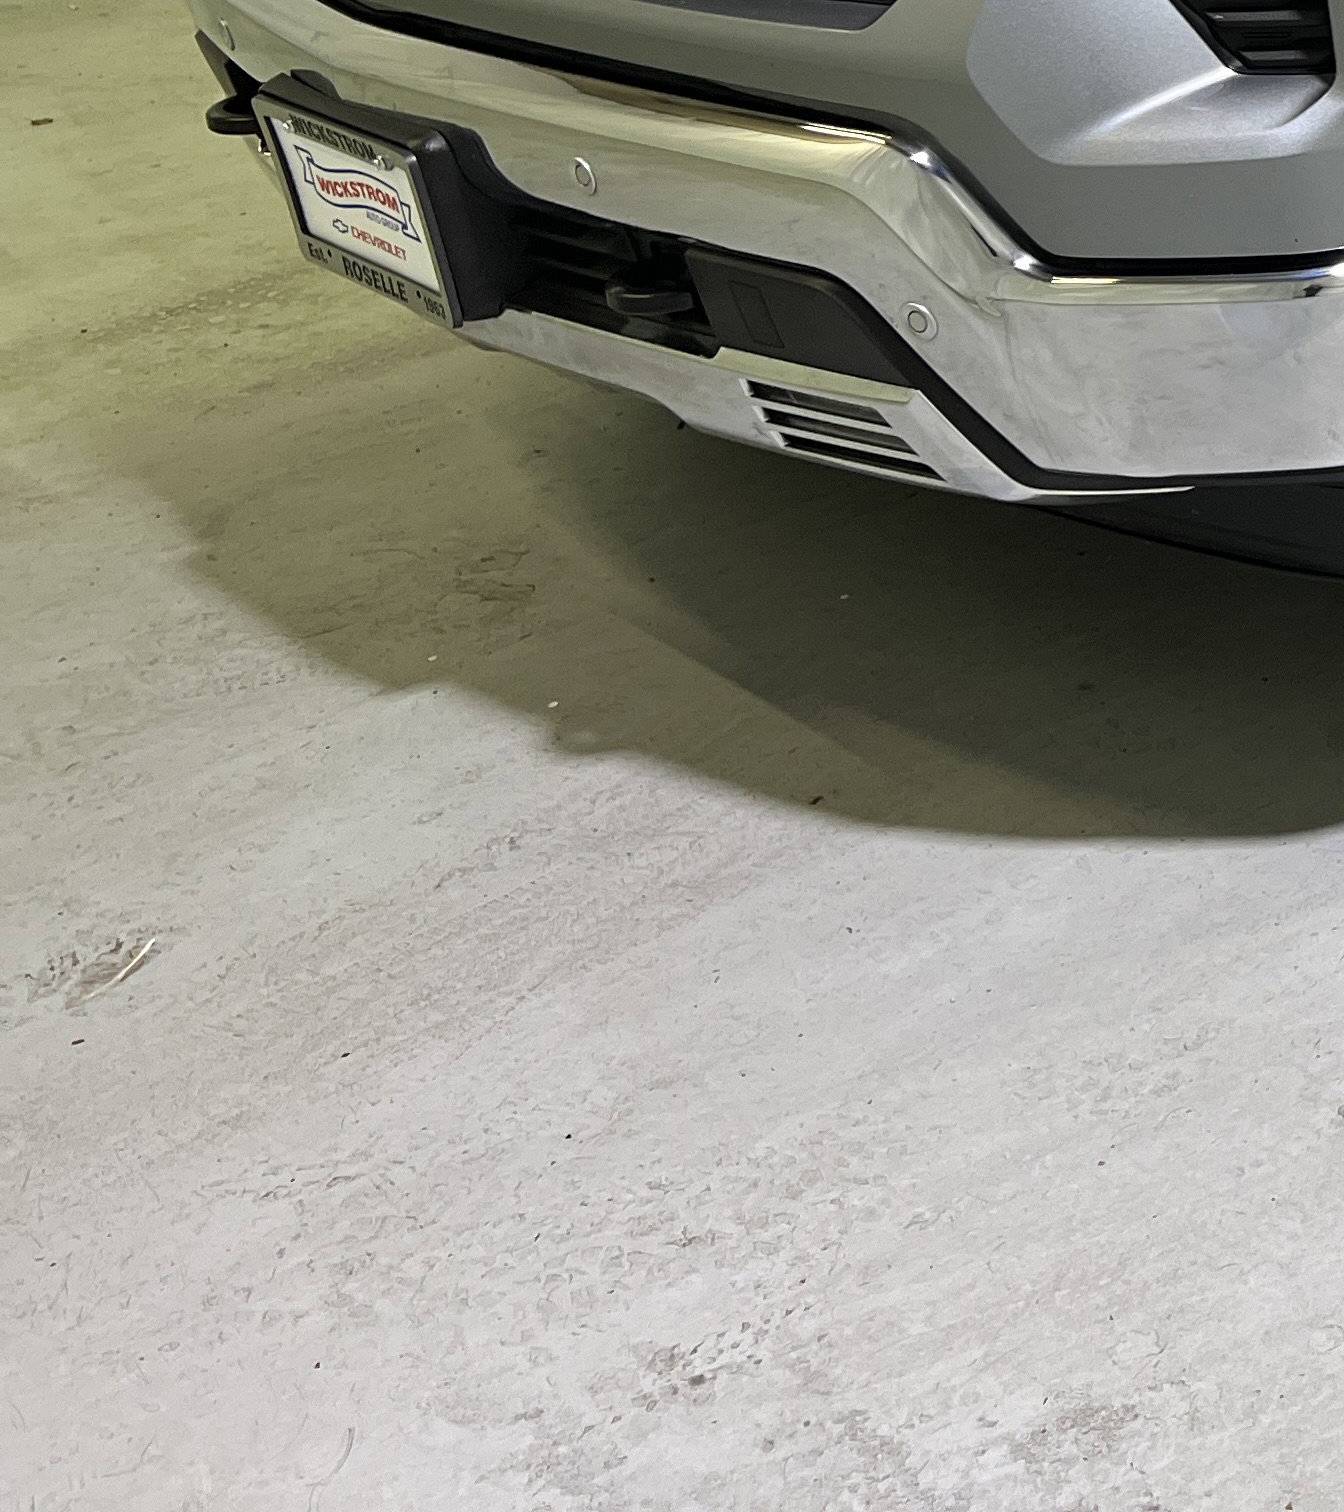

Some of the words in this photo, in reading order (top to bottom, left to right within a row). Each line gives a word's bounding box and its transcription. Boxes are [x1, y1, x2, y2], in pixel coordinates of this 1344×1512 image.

[290, 114, 377, 159] WICKSTROM
[316, 175, 400, 213] WICKSTROM
[351, 226, 406, 260] CHEVROLET
[342, 256, 408, 302] ROSELLE
